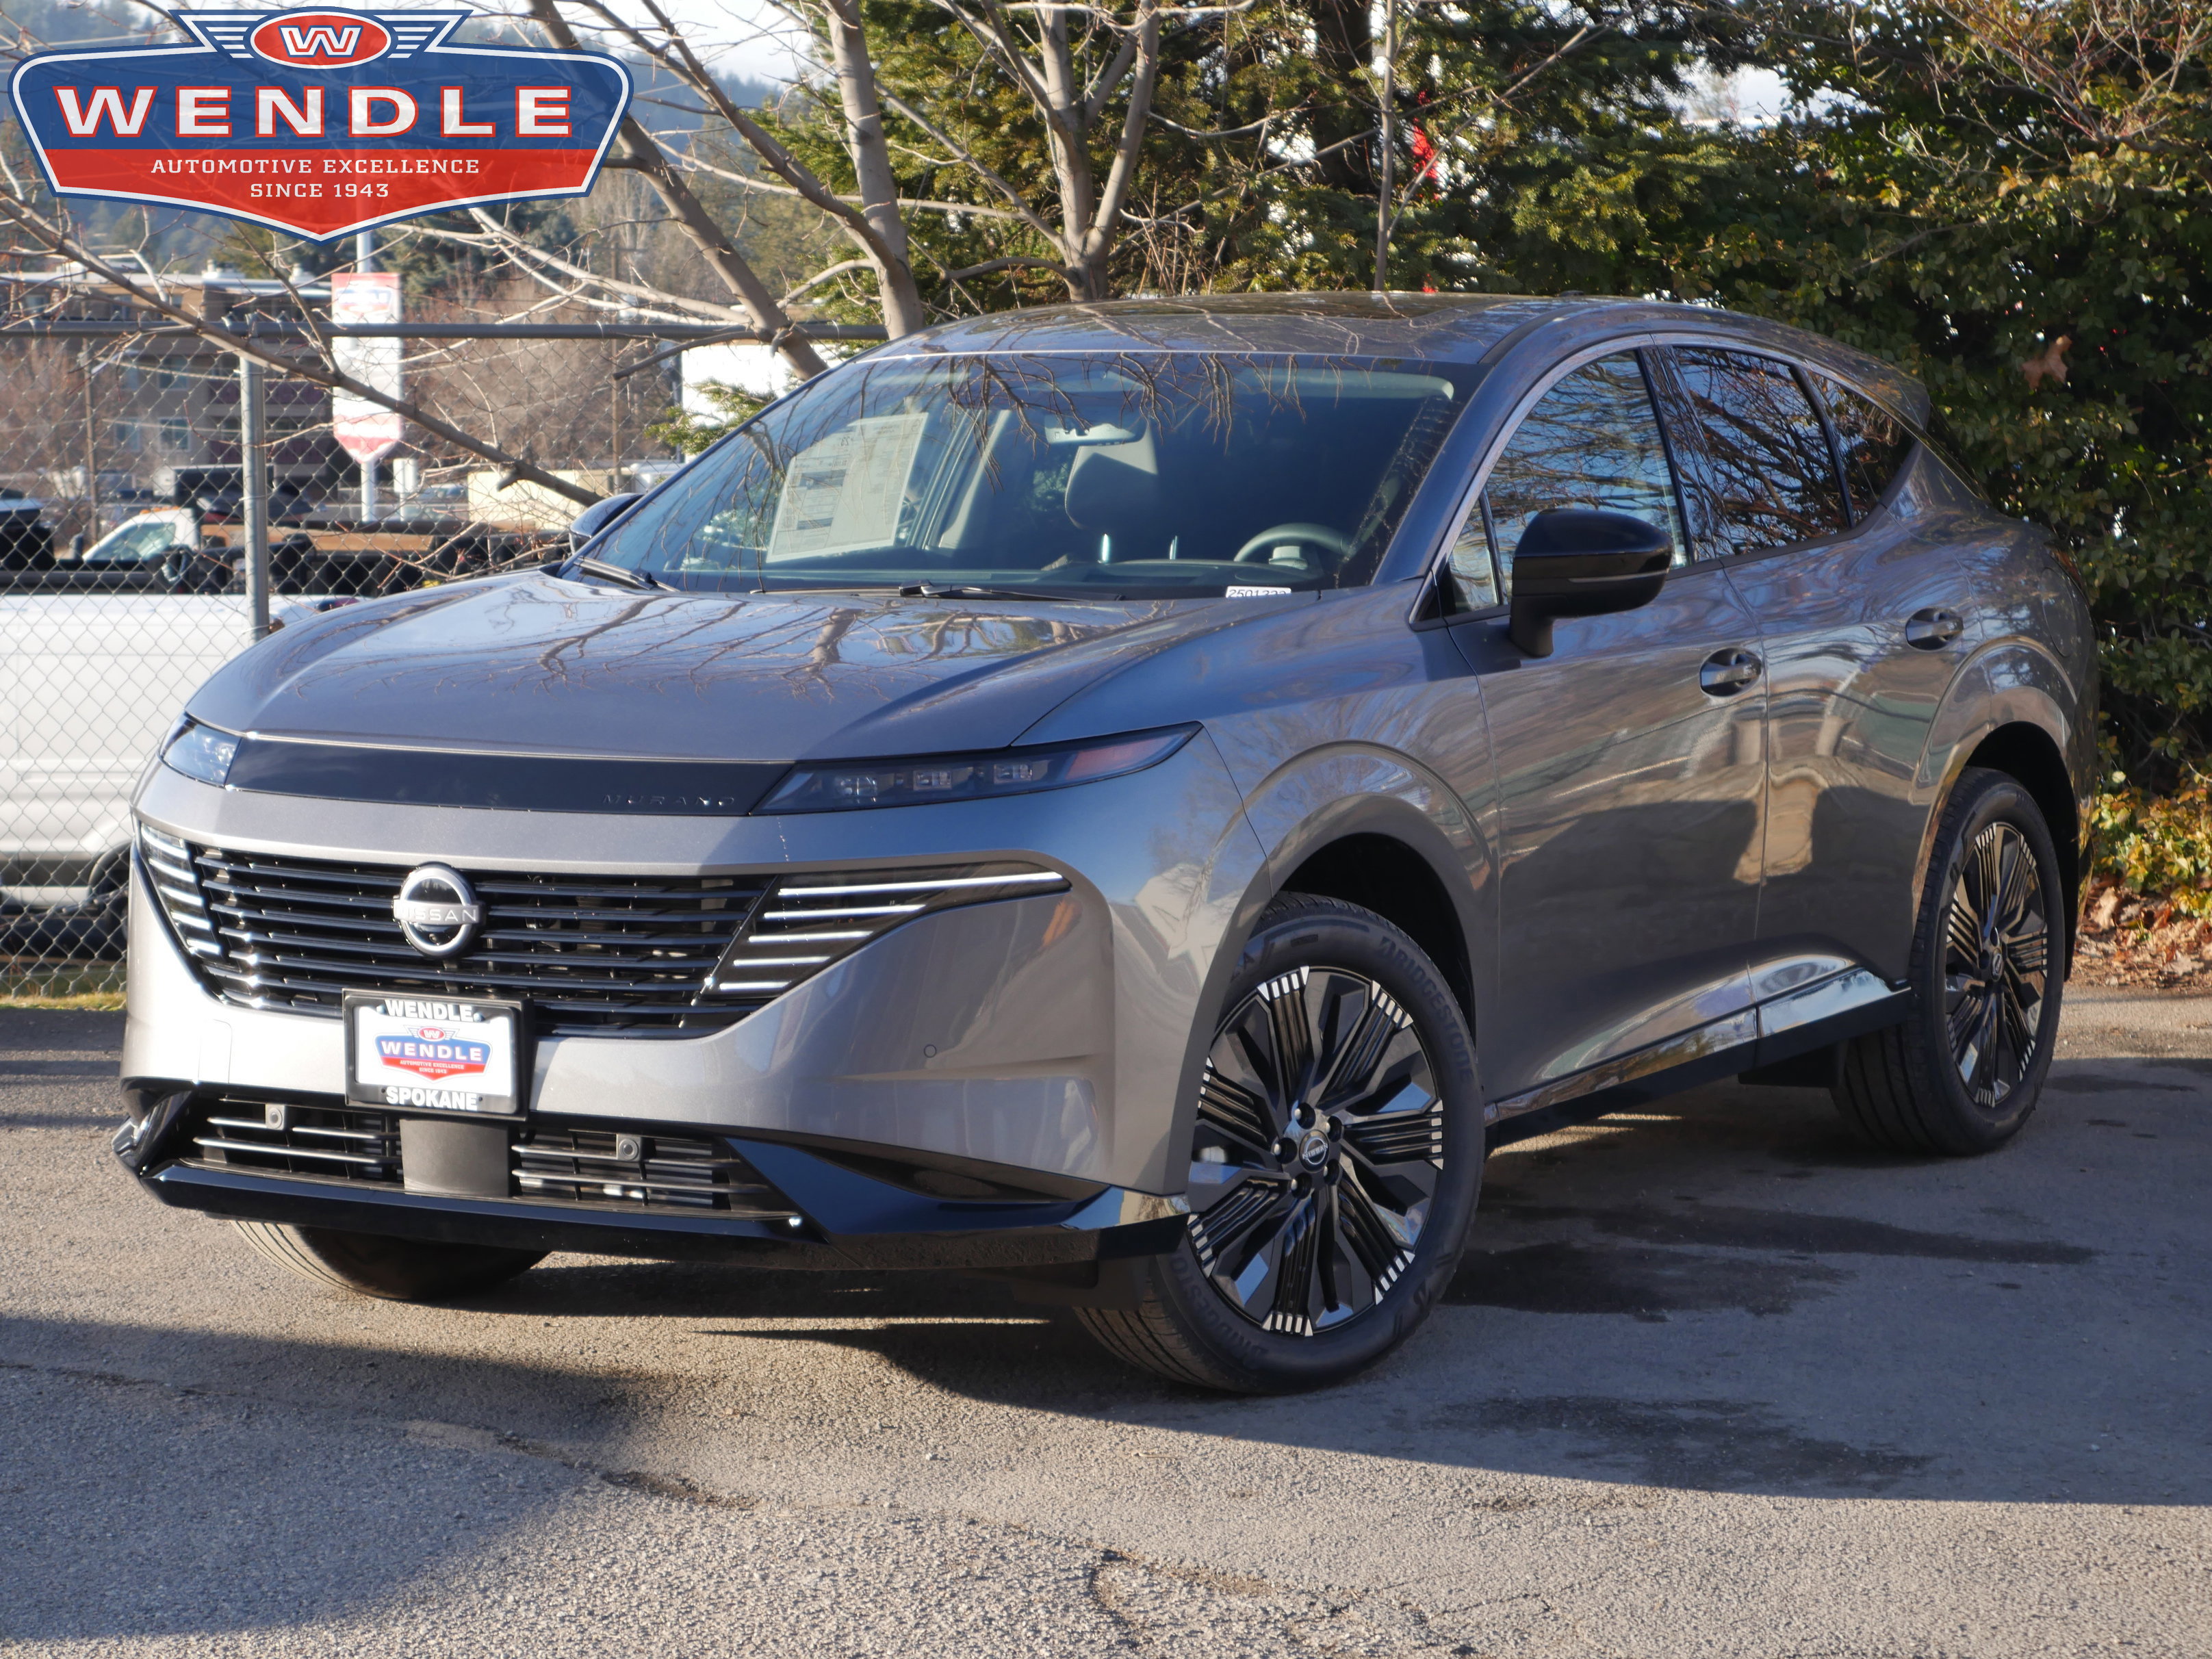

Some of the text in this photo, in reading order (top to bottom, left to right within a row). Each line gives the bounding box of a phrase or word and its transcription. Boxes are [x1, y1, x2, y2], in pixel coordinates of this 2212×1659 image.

[385, 999, 474, 1022] WENDLE
[381, 1041, 482, 1061] WENDLE
[386, 1085, 478, 1111] SPOKANE
